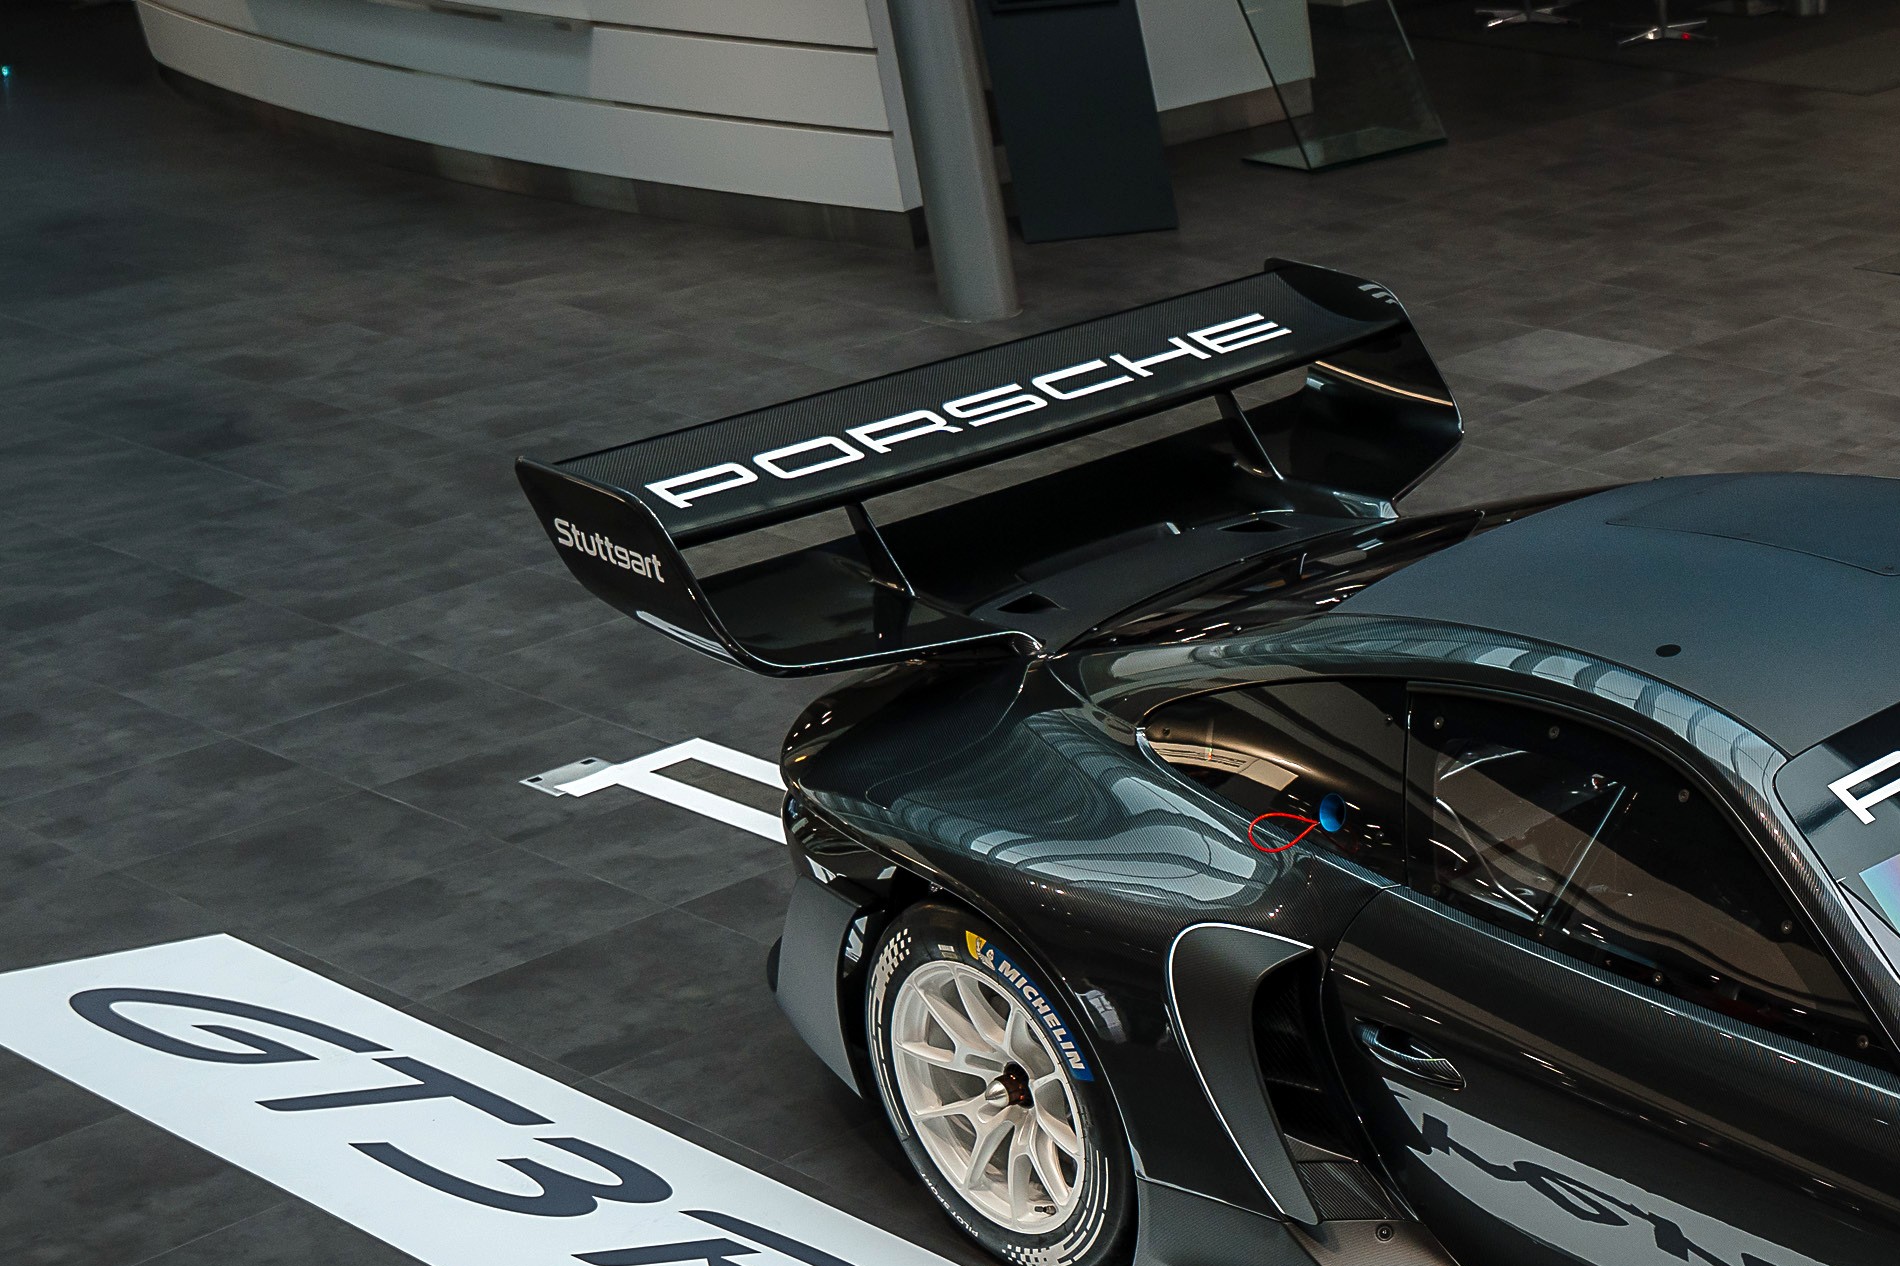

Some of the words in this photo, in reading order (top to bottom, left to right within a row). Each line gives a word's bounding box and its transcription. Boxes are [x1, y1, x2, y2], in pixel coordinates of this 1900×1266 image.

[645, 313, 1291, 509] PORSCHE
[553, 517, 665, 583] Stuttgart
[998, 960, 1086, 1070] MICHELIN
[950, 1211, 979, 1238] PILOT
